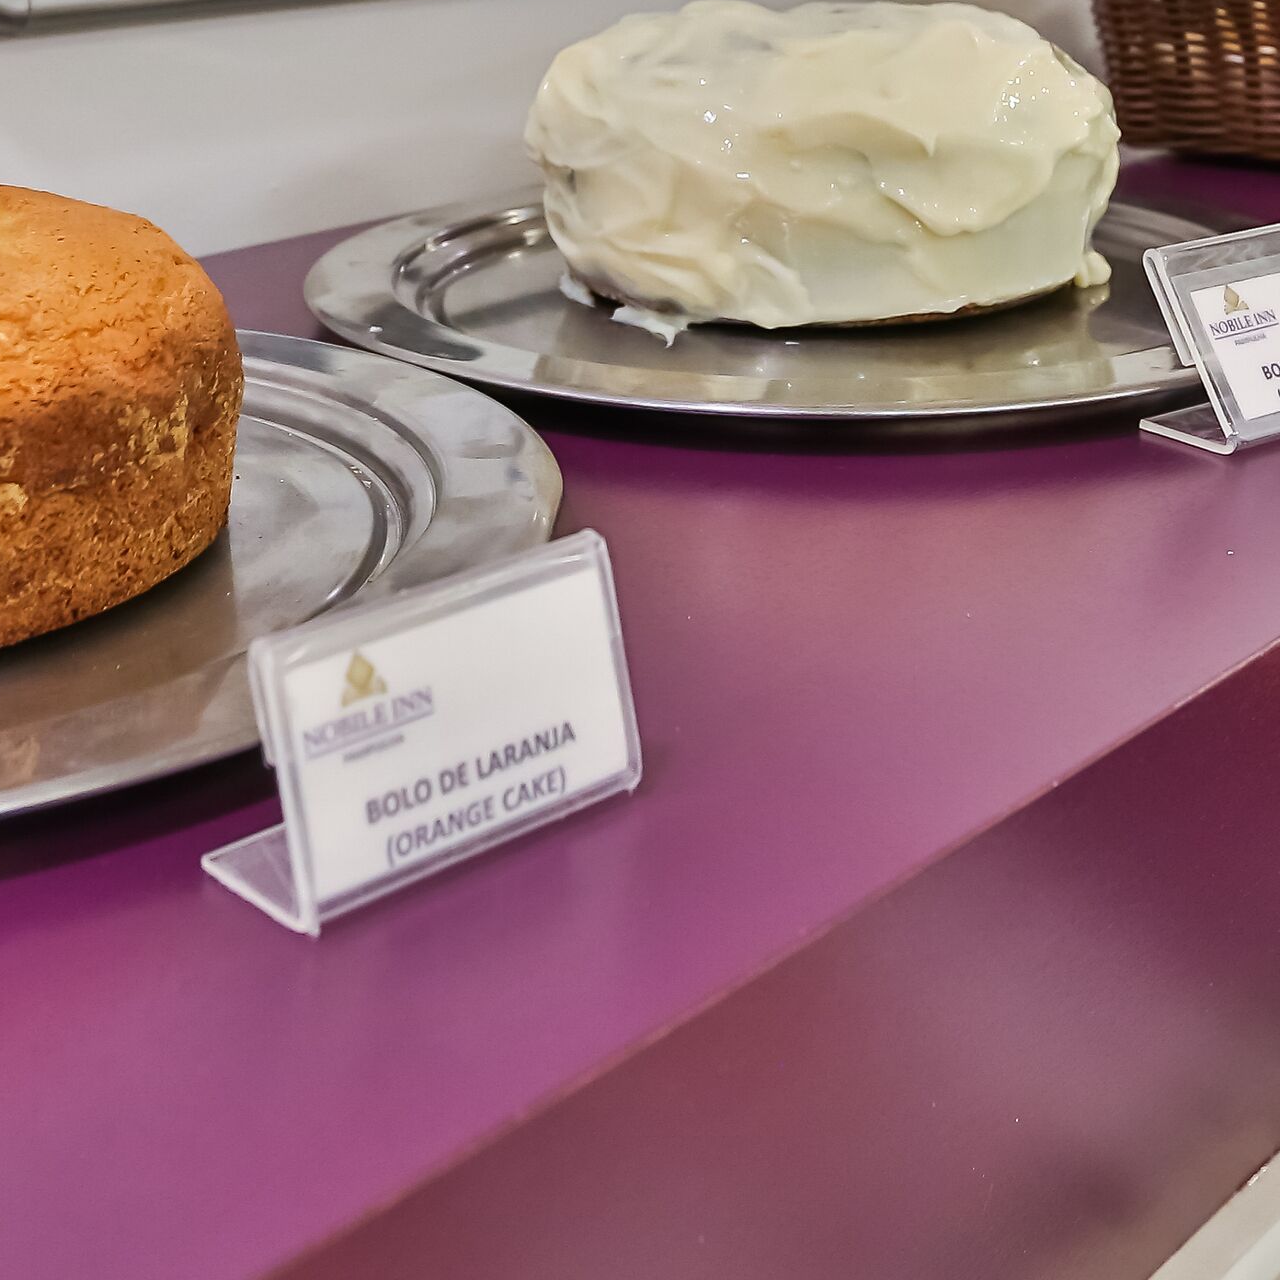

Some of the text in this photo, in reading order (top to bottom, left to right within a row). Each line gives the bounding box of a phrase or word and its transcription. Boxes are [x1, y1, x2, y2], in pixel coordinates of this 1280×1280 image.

[1209, 309, 1278, 337] NOBILE INN
[303, 703, 387, 751] NOBILE
[391, 686, 433, 721] INN
[365, 721, 577, 825] BOLO DE LARANJA
[385, 765, 567, 868] (ORANGE CAKE)
